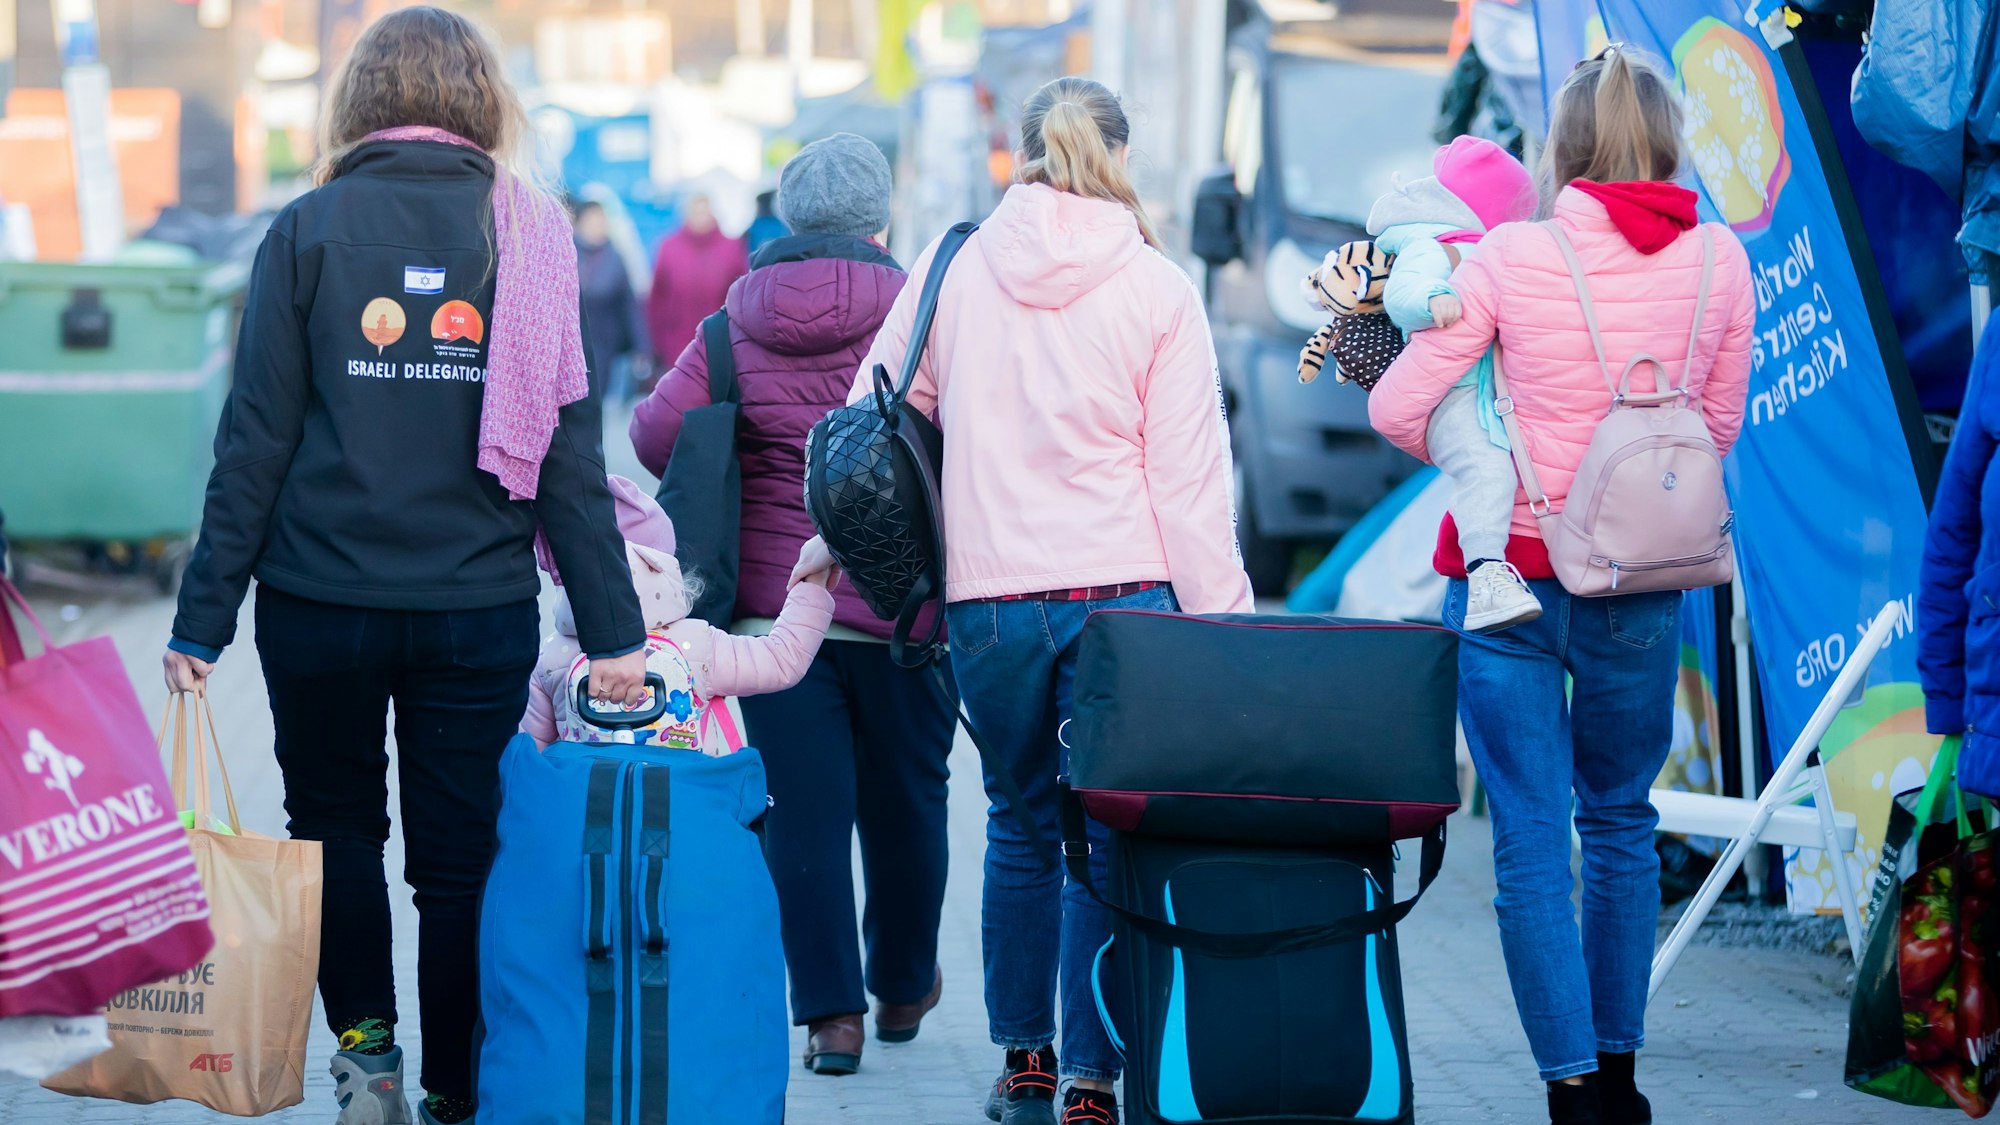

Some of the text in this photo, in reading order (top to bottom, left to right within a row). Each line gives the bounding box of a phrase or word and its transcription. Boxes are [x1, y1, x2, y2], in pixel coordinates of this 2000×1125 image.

[348, 360, 396, 379] ISRAELI
[0, 782, 164, 871] VERONE
[125, 1023, 154, 1034] ПОВТОРНО
[160, 1026, 183, 1036] БЕРЕЖИ
[189, 1053, 234, 1073] АТБ
